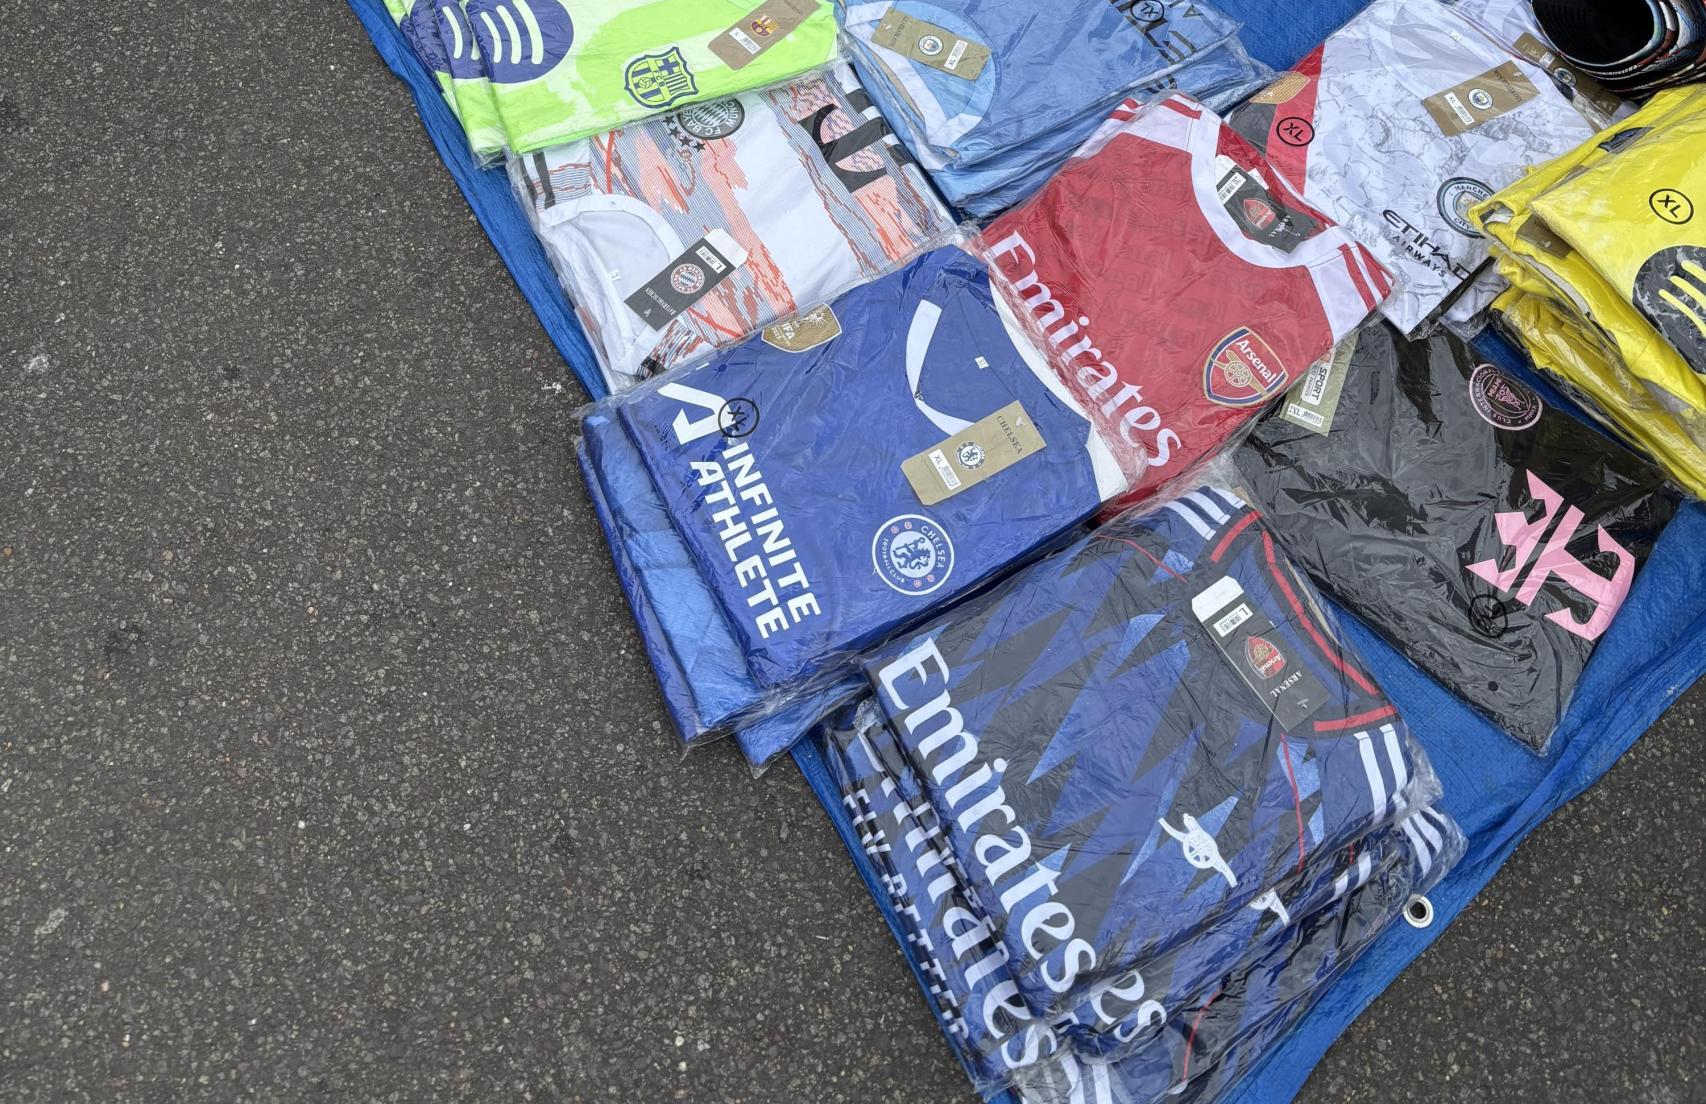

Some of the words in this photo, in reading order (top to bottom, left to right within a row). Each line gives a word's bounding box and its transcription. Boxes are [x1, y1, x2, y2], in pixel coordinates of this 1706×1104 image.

[1283, 121, 1306, 143] XL
[1453, 216, 1473, 232] CITY
[1656, 197, 1683, 219] XL
[1381, 209, 1472, 283] ETIHAD
[1391, 234, 1448, 279] AIRWAYS
[985, 229, 1183, 468] Emirates
[1235, 339, 1278, 384] Arsenal
[1311, 366, 1328, 402] SPORT
[996, 415, 1023, 455] CHELSEA
[689, 460, 791, 639] ATHLETE
[721, 442, 821, 623] INFINITE
[920, 524, 947, 570] CHELSEA
[881, 537, 896, 576] FOOTBALL
[889, 568, 906, 584] CLUB
[1269, 669, 1303, 698] ARSENAL
[877, 636, 1100, 996] Emirates
